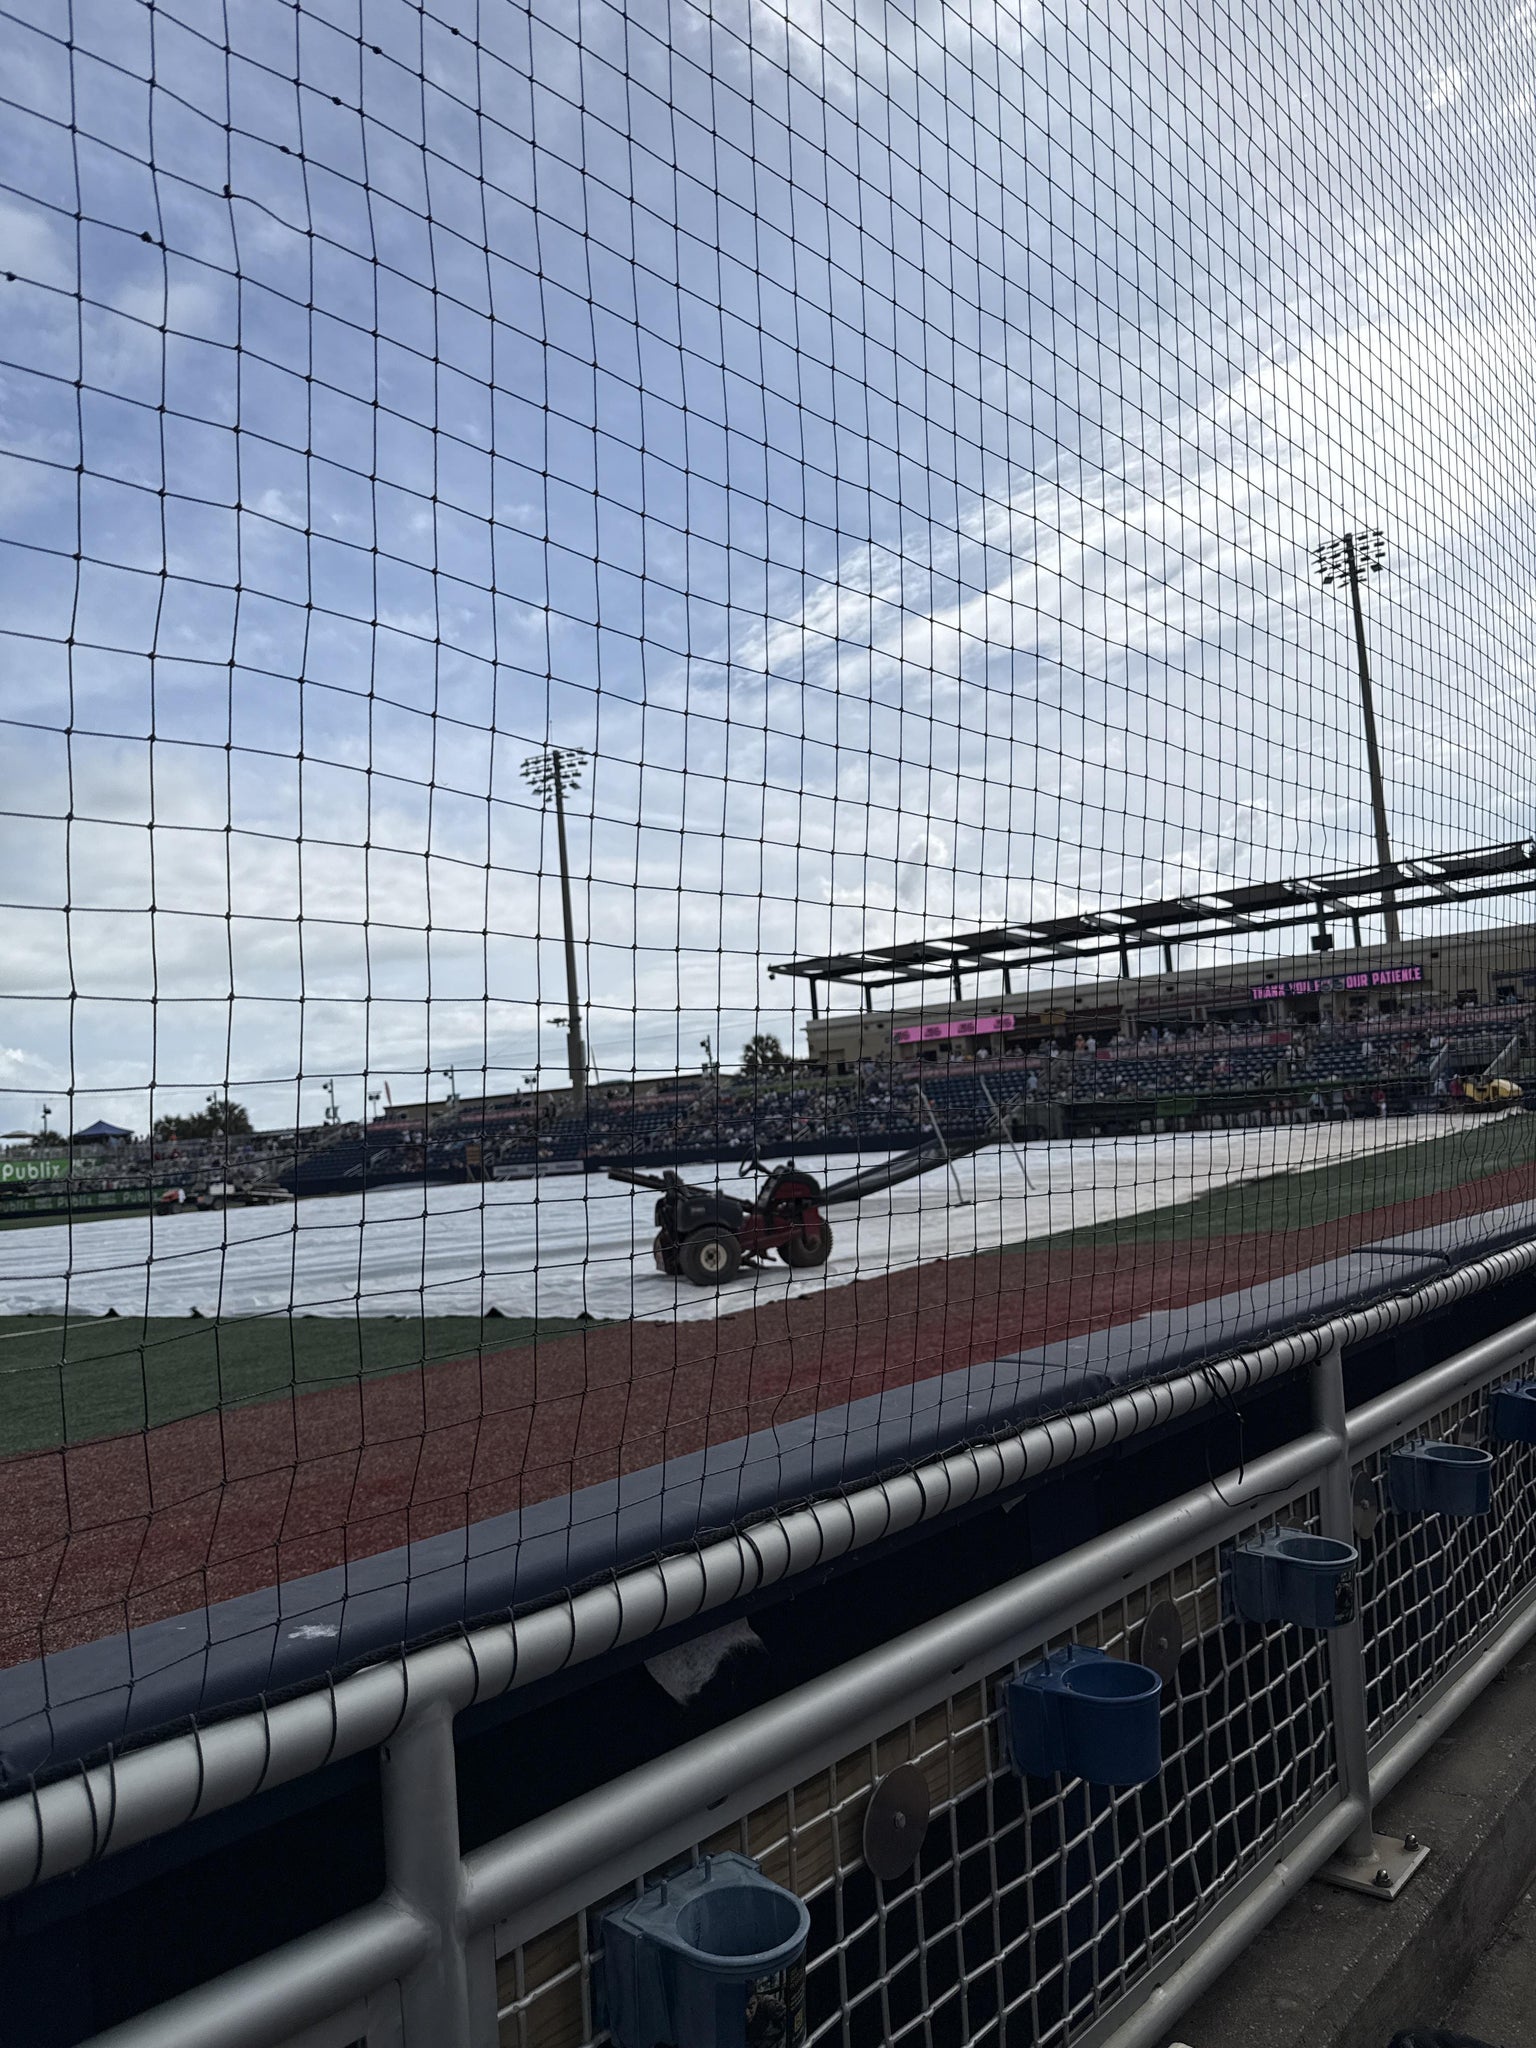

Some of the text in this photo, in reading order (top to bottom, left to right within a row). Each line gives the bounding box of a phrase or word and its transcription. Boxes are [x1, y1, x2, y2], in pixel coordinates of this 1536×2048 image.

[1252, 984, 1285, 998] THANK
[1338, 974, 1368, 988] OUR
[2, 1161, 60, 1181] Publix
